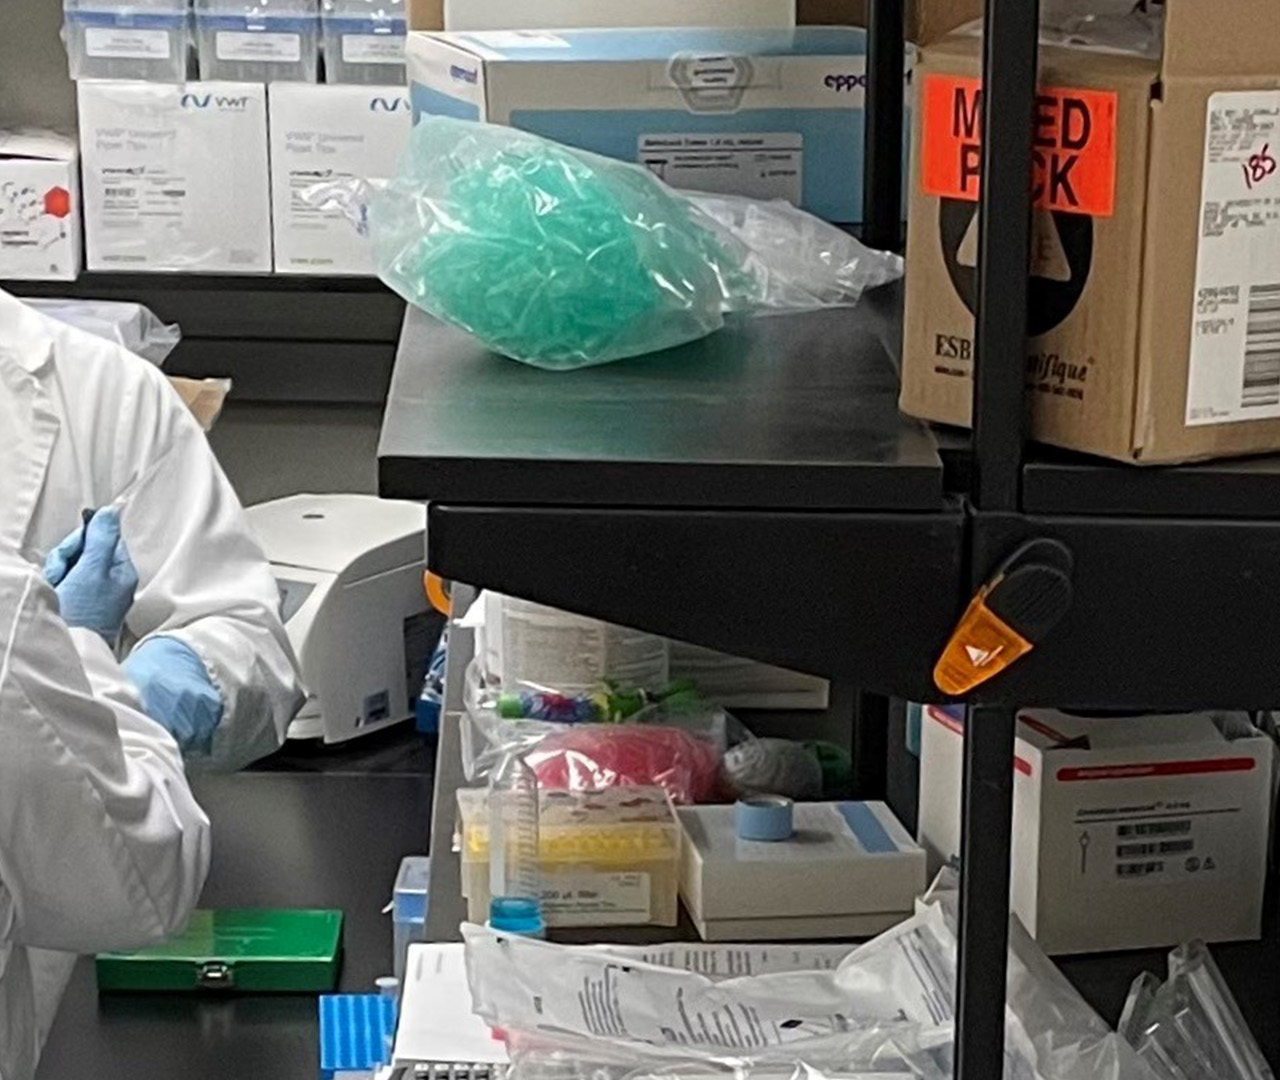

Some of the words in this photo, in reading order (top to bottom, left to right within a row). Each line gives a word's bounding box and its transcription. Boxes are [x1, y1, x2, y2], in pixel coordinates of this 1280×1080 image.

[952, 87, 1092, 150] MED
[959, 143, 1079, 206] PCK
[935, 333, 972, 360] ESB
